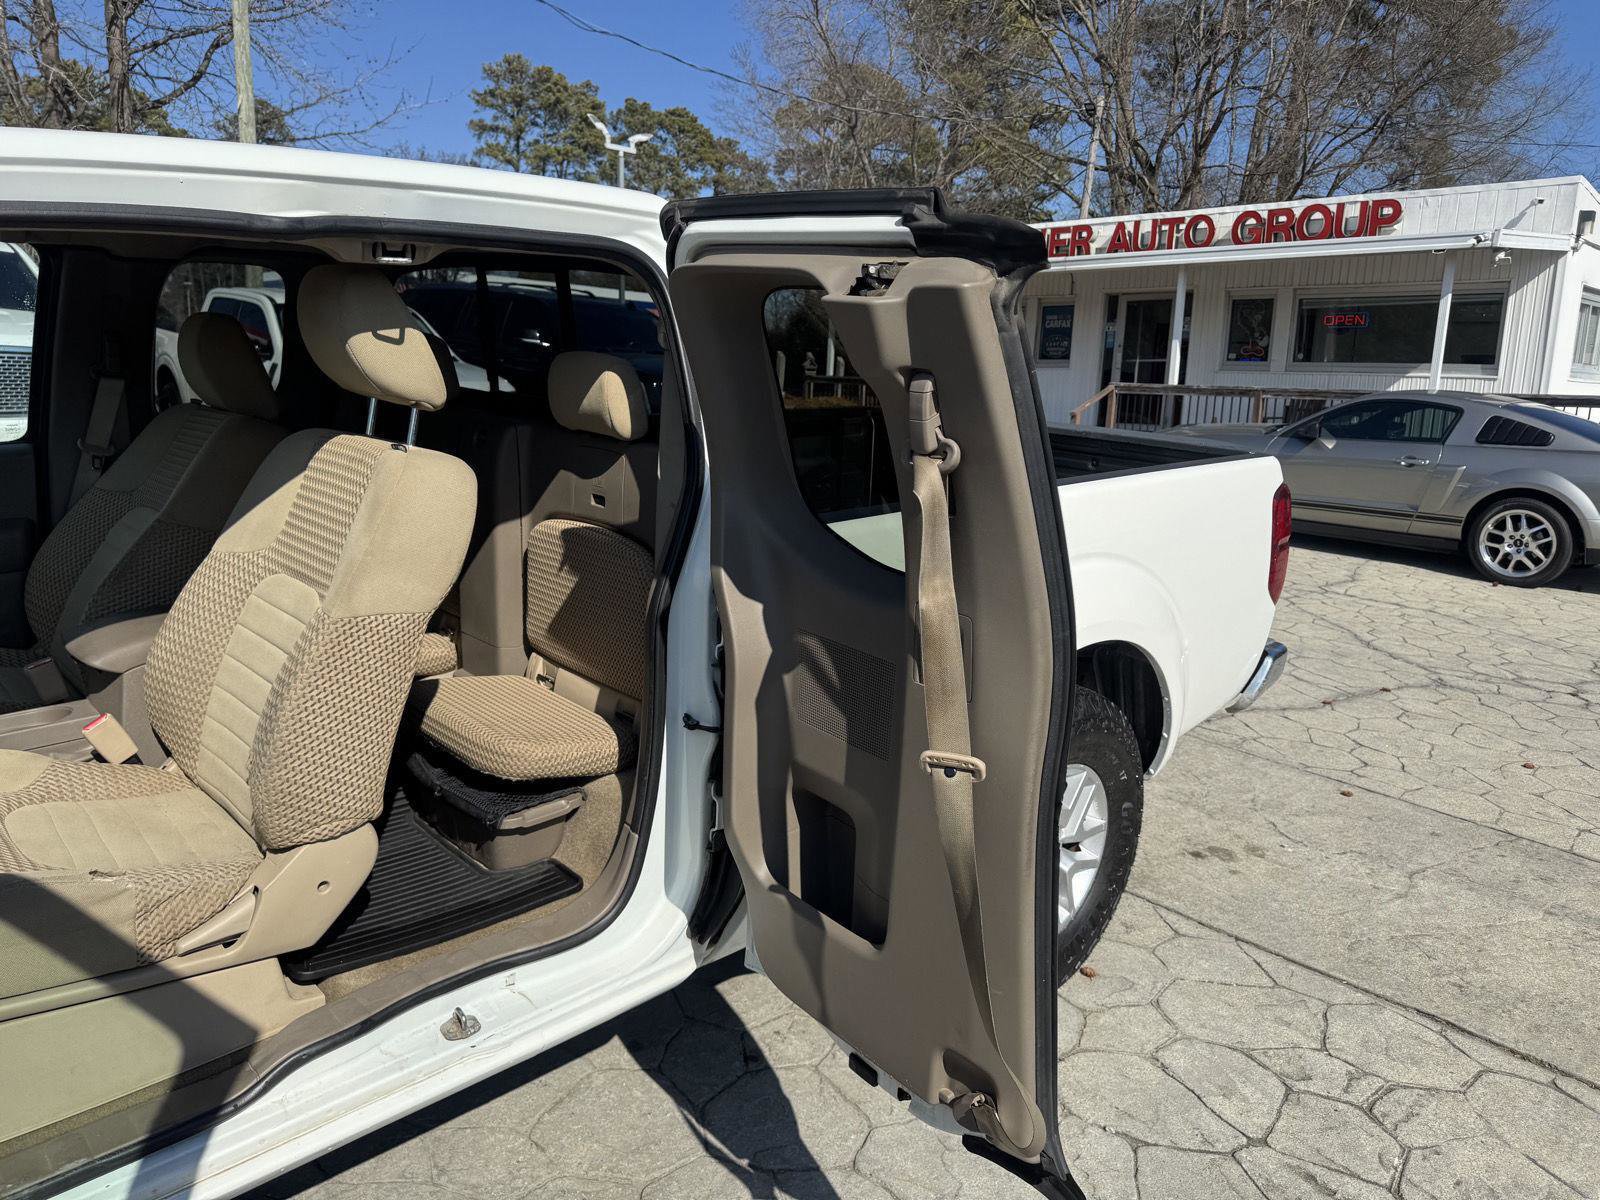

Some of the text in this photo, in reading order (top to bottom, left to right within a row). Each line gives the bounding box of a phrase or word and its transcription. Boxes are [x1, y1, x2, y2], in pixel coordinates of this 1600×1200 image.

[1041, 198, 1403, 258] ER AUTO GROUP
[1045, 319, 1072, 329] CARFAX
[1323, 314, 1366, 326] OPEN
